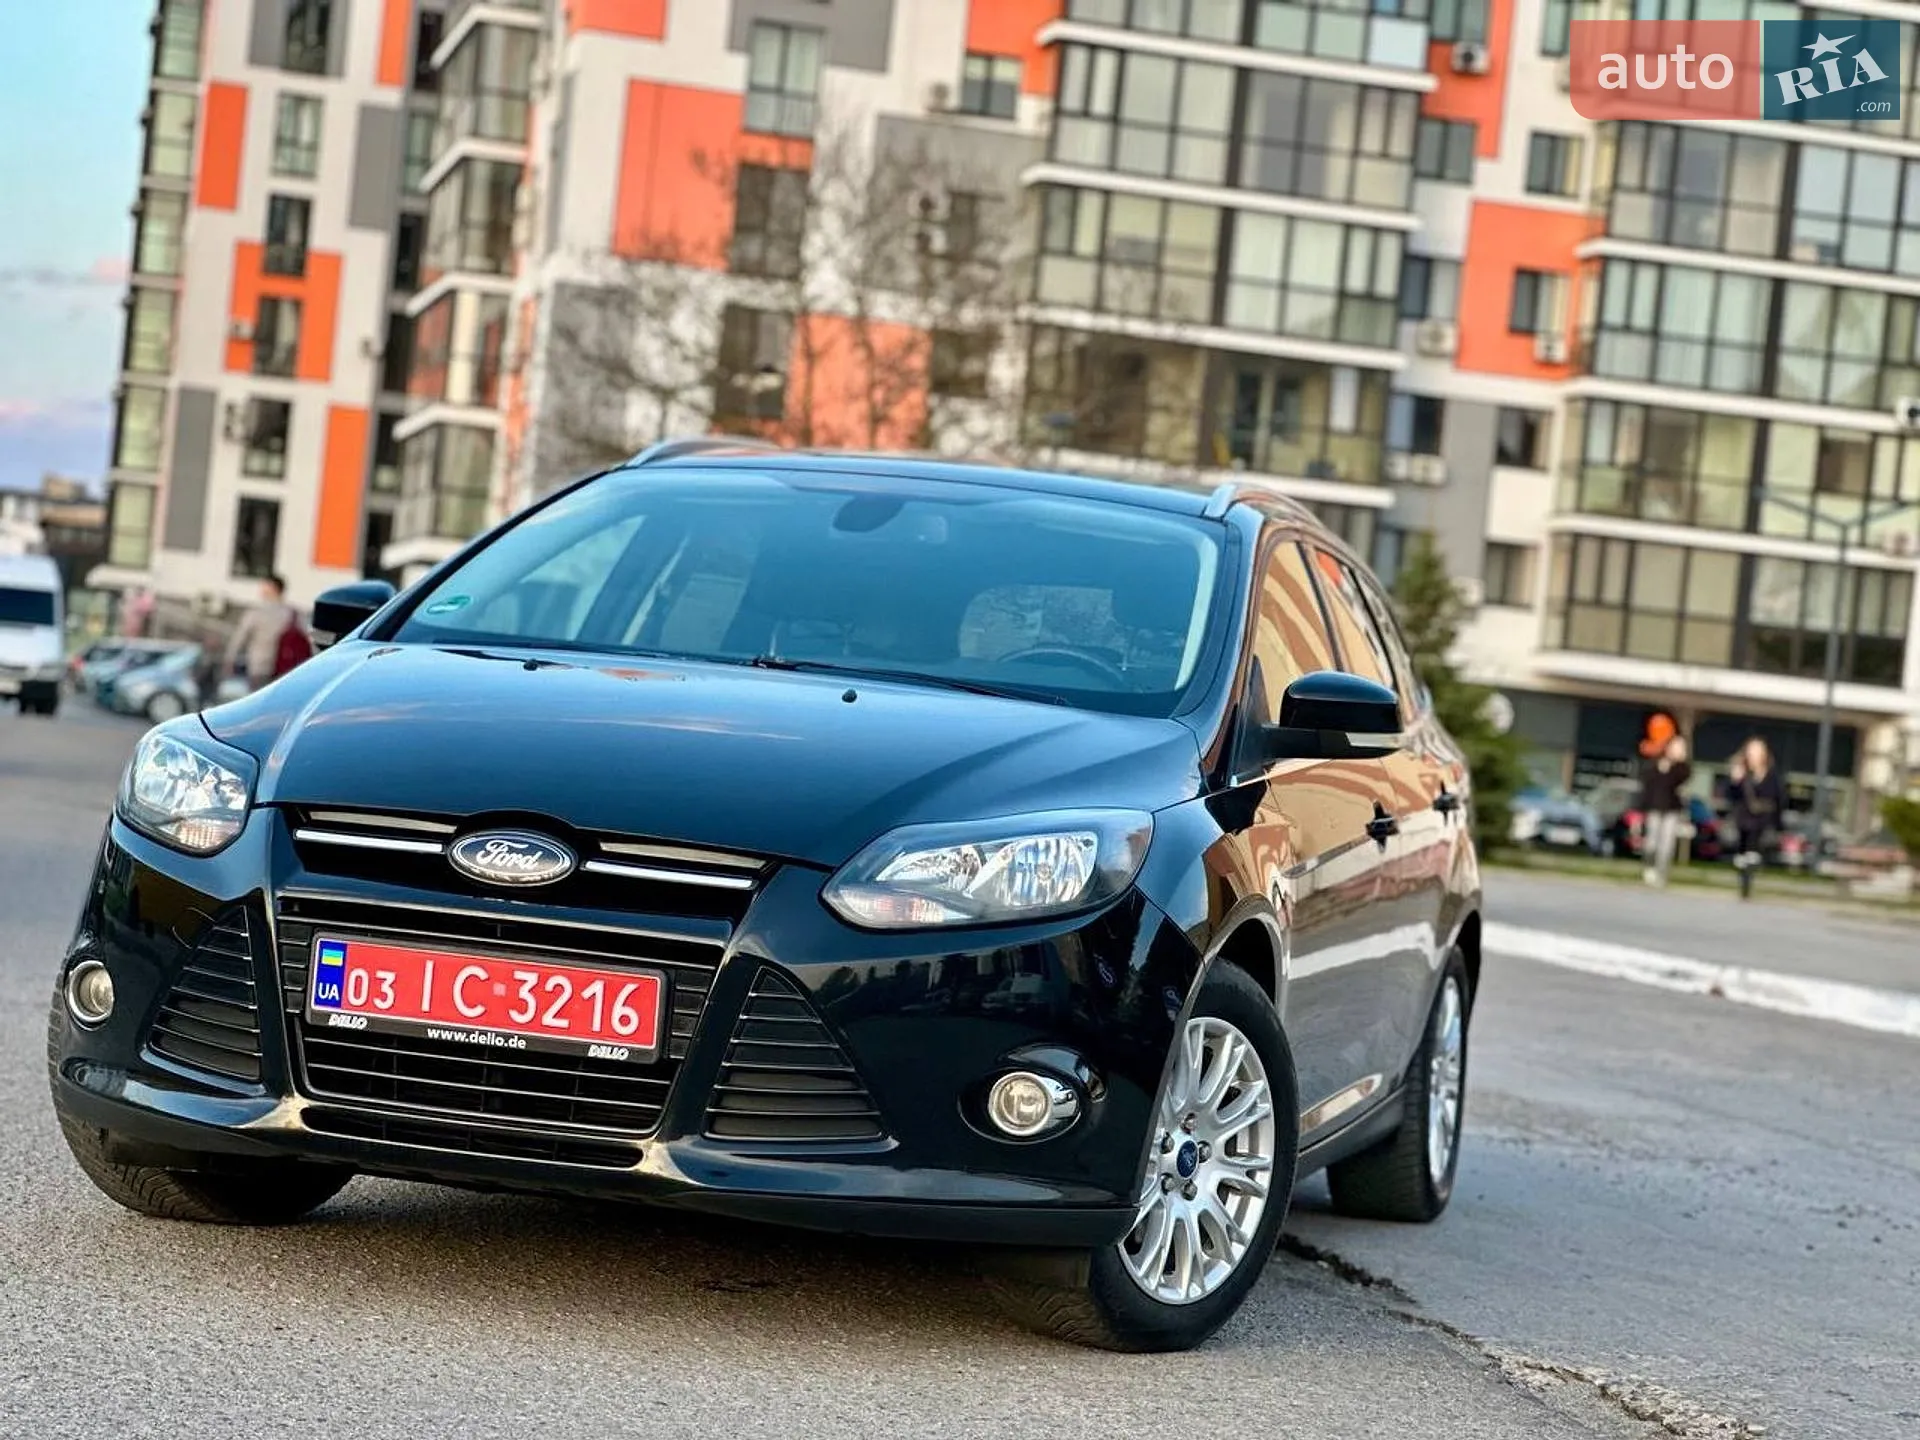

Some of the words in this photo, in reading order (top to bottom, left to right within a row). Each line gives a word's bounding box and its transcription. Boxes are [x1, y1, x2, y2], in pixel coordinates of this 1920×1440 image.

[476, 839, 543, 871] Ford
[317, 982, 341, 1001] UA
[346, 967, 397, 1010] 03
[508, 969, 640, 1036] 3216
[427, 1027, 527, 1050] www.dello.de
